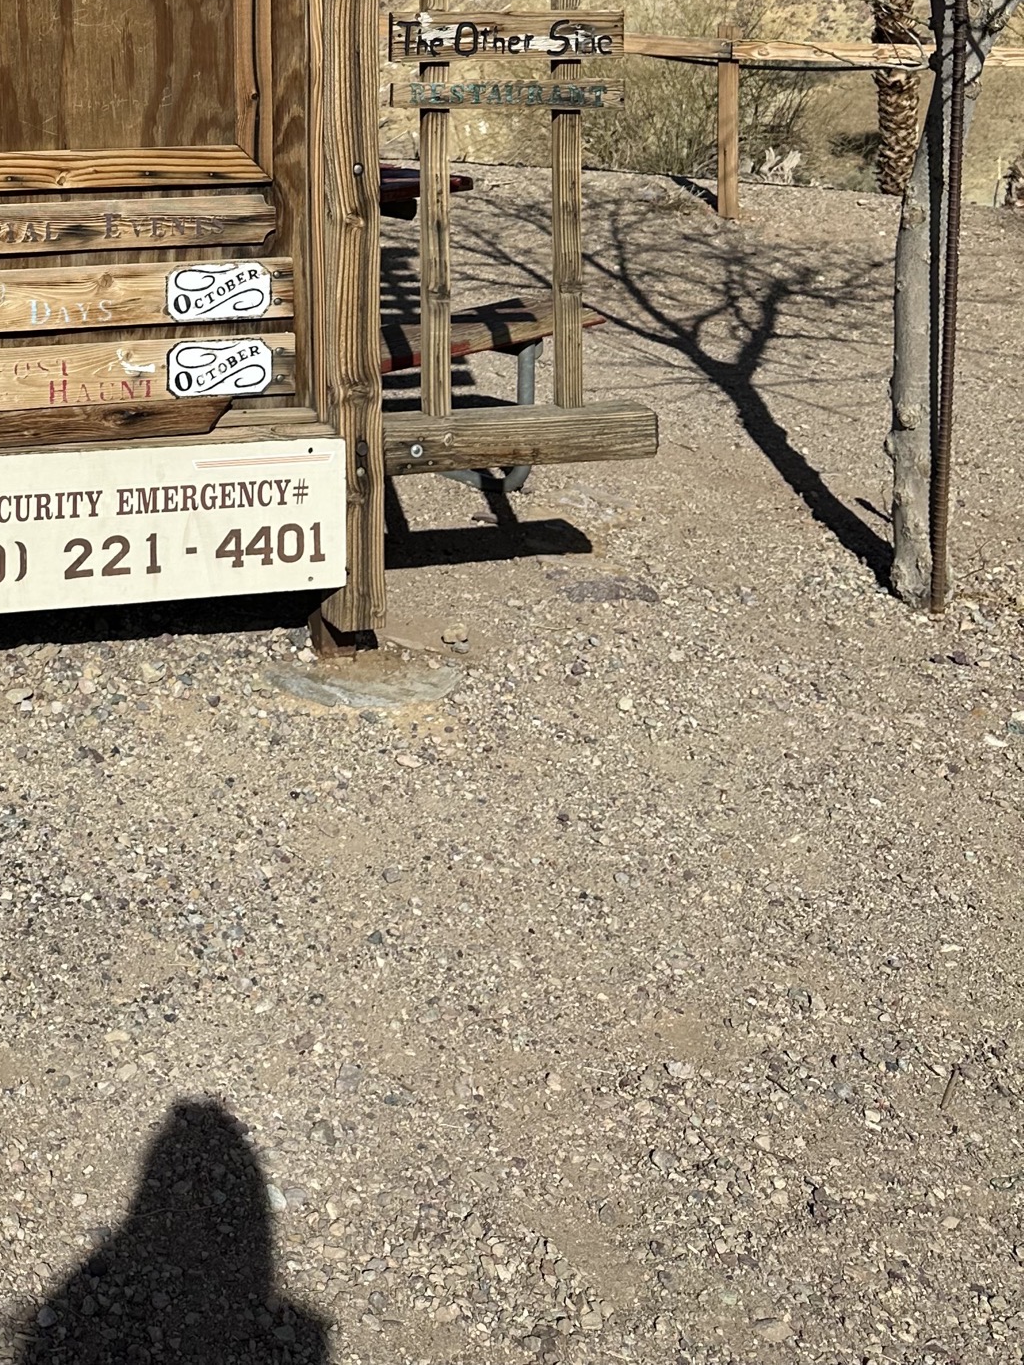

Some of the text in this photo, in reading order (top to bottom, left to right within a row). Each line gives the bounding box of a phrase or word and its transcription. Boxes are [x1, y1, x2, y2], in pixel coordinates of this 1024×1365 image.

[397, 21, 444, 57] The
[454, 21, 534, 57] Other
[408, 83, 608, 107] RESTAURANT
[103, 213, 227, 239] EVENTS
[174, 269, 260, 314] OCTOBER
[26, 299, 114, 326] DAYS
[174, 346, 262, 392] OCTOBER
[48, 379, 157, 405] HAUNT
[116, 478, 310, 516] EMERGENCY#
[63, 532, 163, 580] 221
[214, 522, 326, 569] 4401
